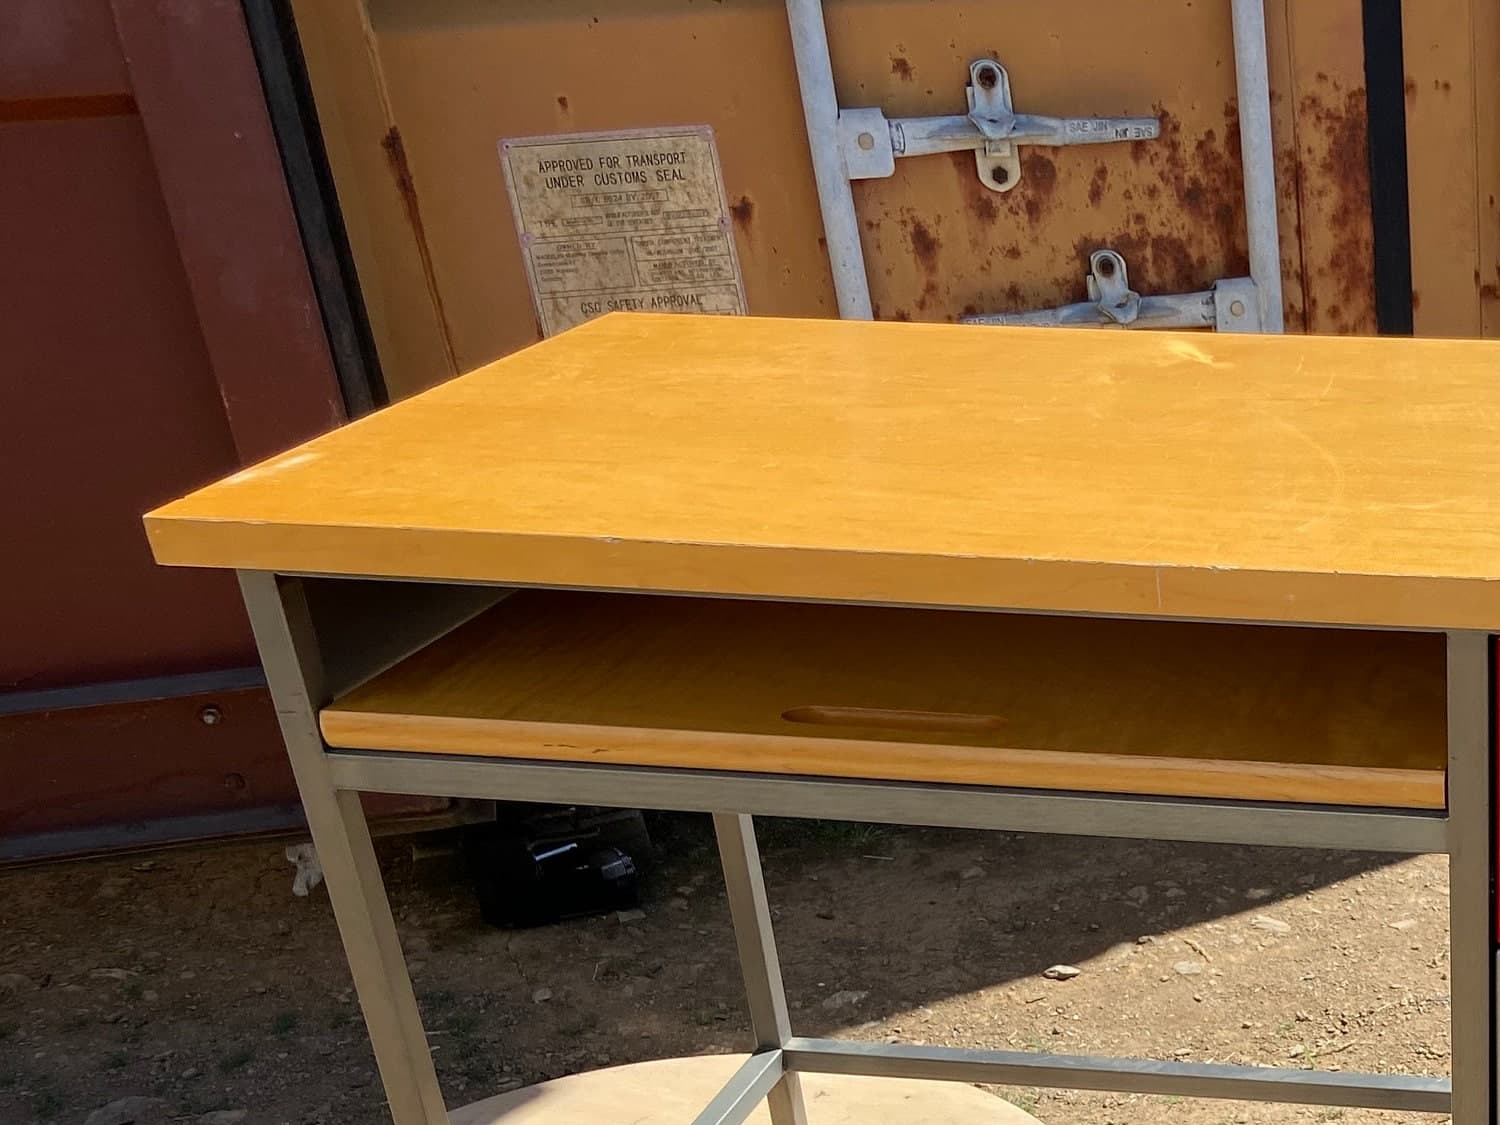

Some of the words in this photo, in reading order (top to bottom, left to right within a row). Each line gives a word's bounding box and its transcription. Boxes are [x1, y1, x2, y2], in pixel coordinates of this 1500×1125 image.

[538, 157, 594, 174] APPROVED
[599, 156, 621, 169] FOR
[626, 151, 687, 168] TRANSPORT
[545, 175, 585, 190] UNDER
[594, 170, 648, 186] CUSTOMS
[656, 168, 687, 183] SEAL
[607, 297, 645, 312] SAFETY
[651, 294, 703, 309] APPROVAL
